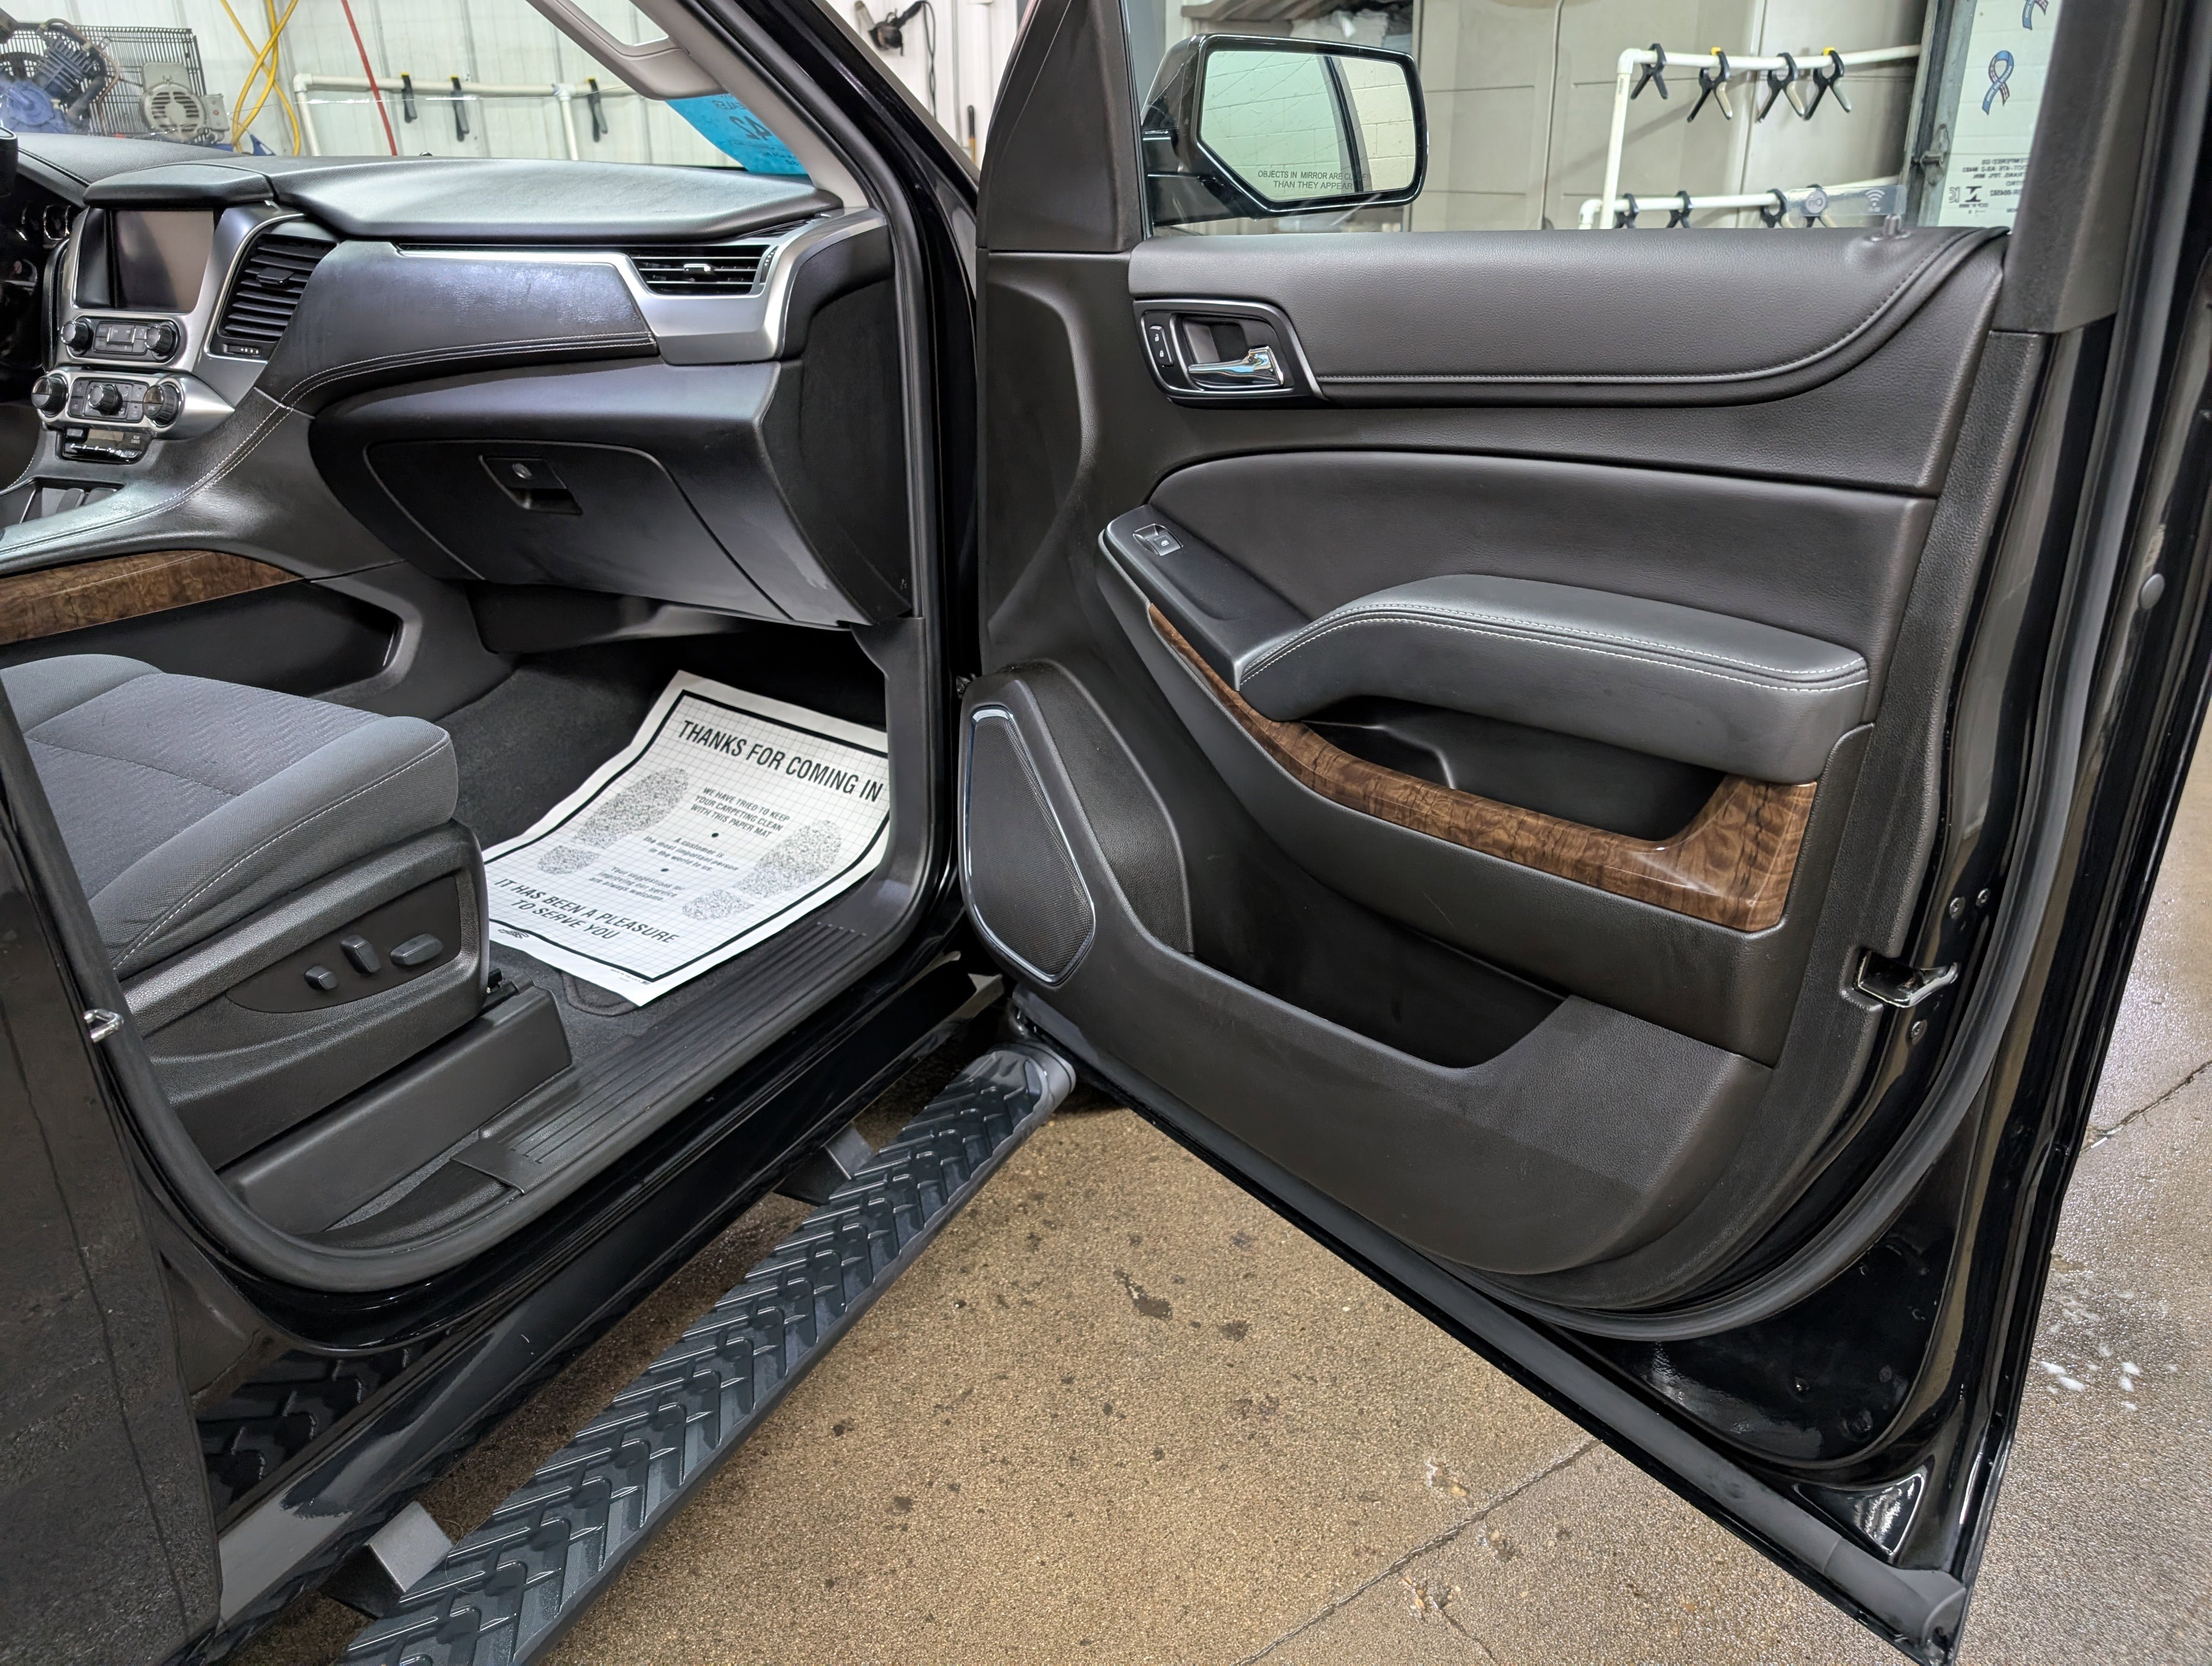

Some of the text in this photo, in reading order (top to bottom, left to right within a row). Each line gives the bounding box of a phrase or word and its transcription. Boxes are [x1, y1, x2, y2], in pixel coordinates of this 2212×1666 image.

[1258, 170, 1289, 178] OBJECTS
[1320, 182, 1353, 190] APPEAR
[678, 720, 884, 803] THANKS FOR COMING IN
[691, 804, 772, 838] WITH THIS PAPER MAT
[695, 795, 784, 831] YOUR CARPETING CLEAN
[703, 787, 790, 822] WE HAVE TRIED TO KEEP
[644, 836, 738, 872] the most important person
[671, 855, 694, 865] world
[681, 841, 716, 855] customer
[511, 885, 546, 900] HAS
[543, 896, 586, 914] BEEN
[582, 909, 597, 918] A
[595, 913, 680, 944] PLEASURE
[511, 900, 620, 939] TO SERVE YOU
